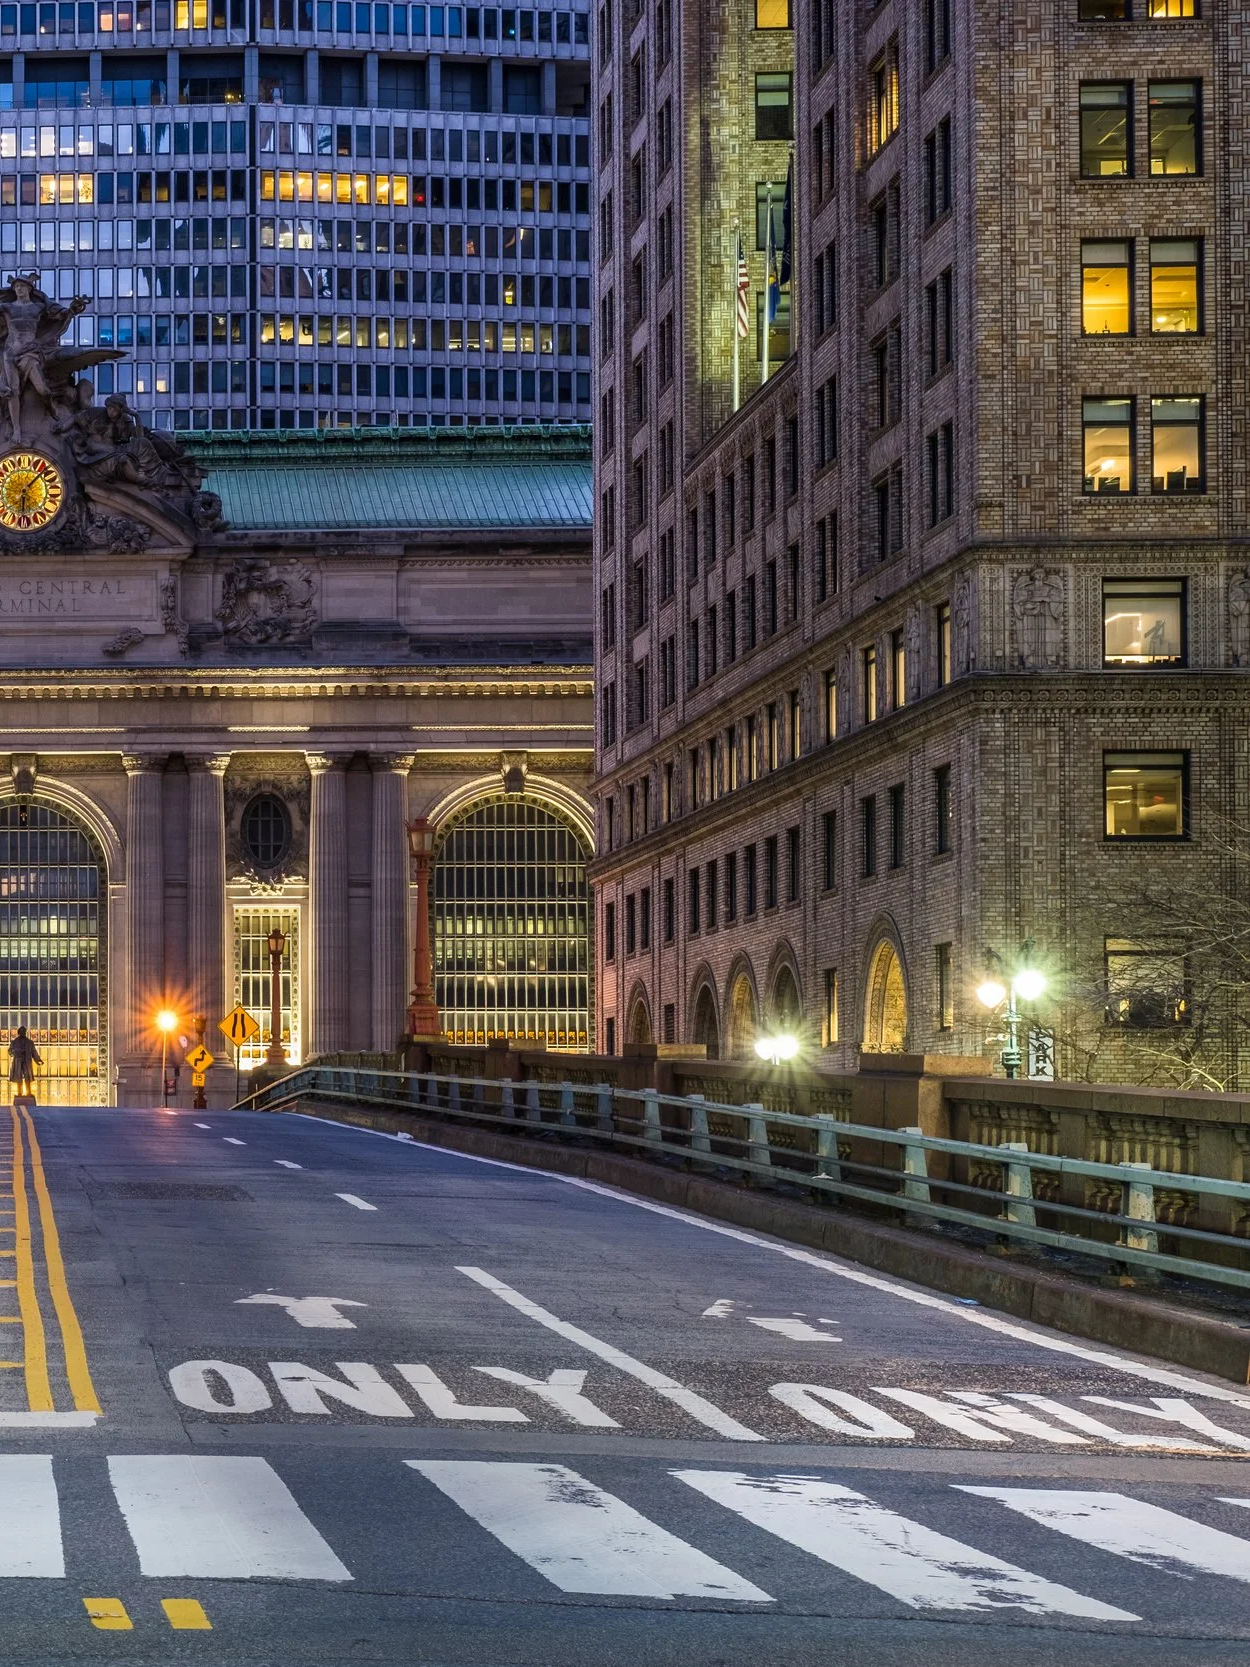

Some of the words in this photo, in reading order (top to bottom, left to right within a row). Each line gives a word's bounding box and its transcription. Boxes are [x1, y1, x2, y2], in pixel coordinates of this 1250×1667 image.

[20, 455, 29, 468] XII
[19, 580, 126, 595] CENTRAL
[168, 1359, 622, 1428] ONLY
[767, 1382, 1250, 1452] ONLY
